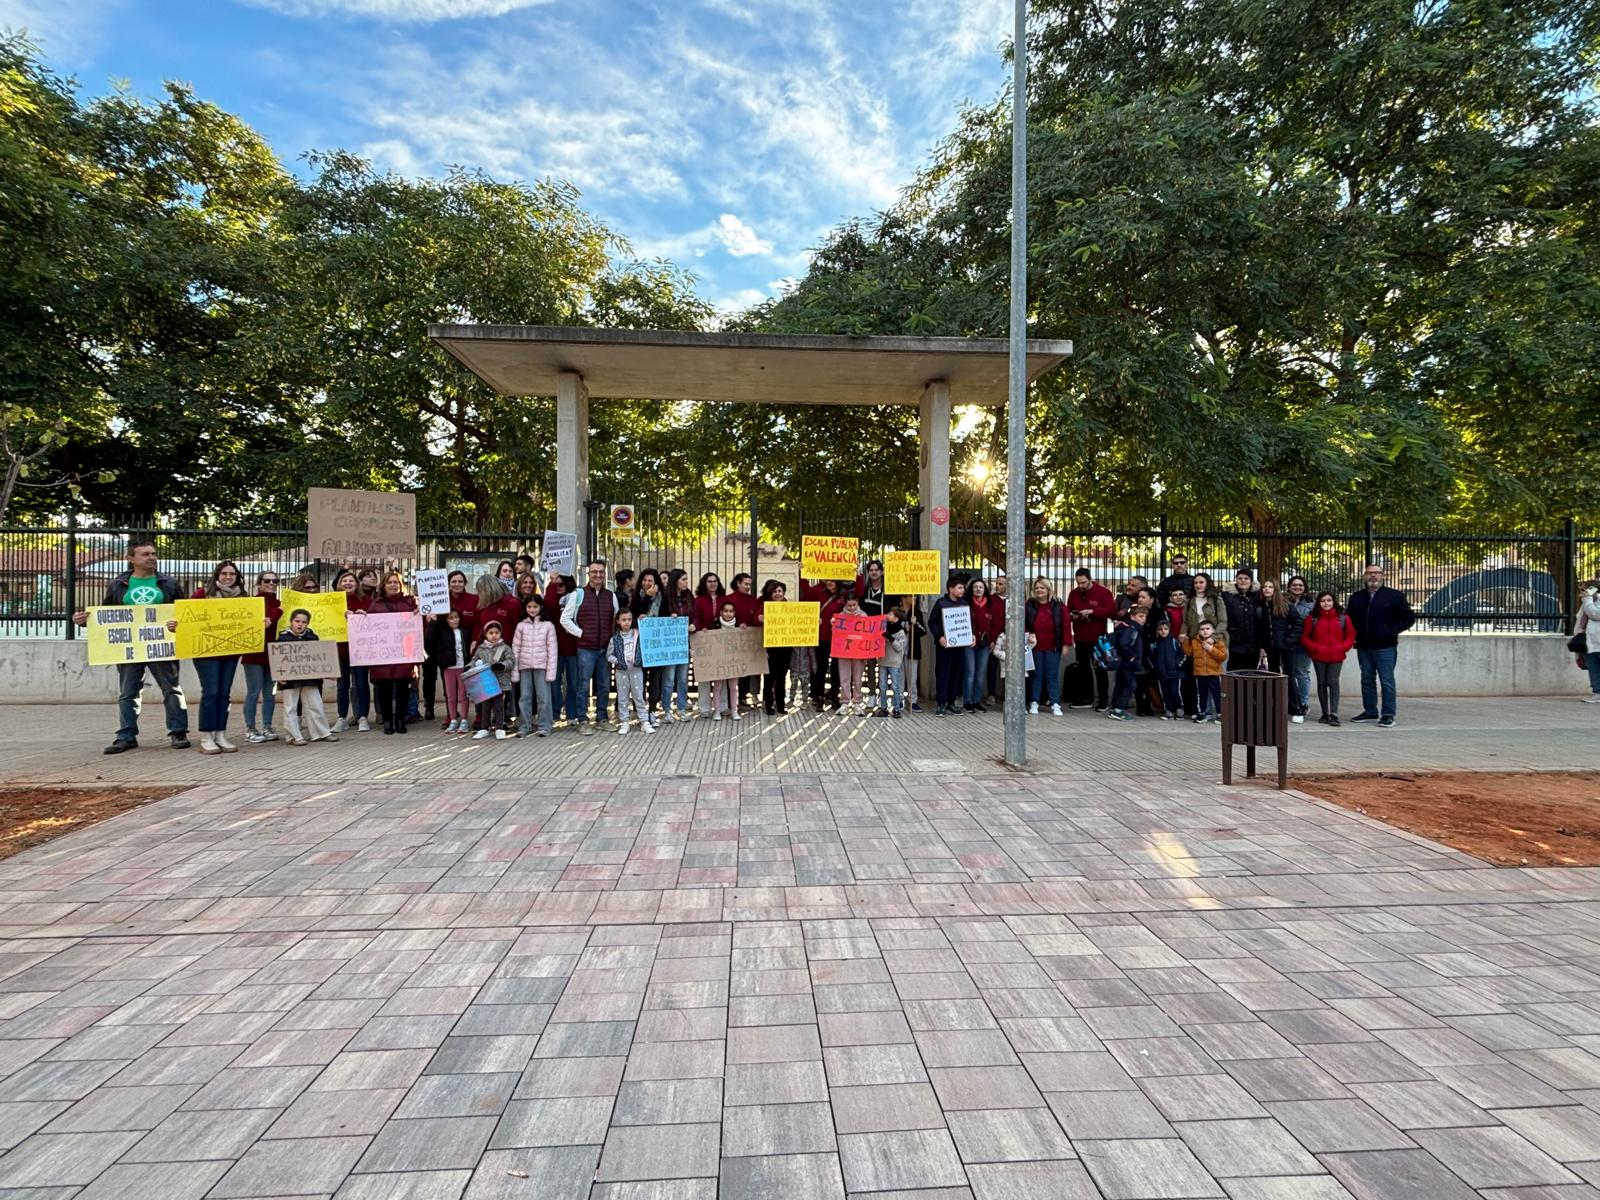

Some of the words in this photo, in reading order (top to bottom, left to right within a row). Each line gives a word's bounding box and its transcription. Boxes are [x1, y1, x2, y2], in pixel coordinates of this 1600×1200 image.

[804, 538, 828, 547] ESCOLA
[545, 550, 572, 559] QUALITAT
[806, 567, 822, 575] ARA
[97, 608, 134, 625] QUEREMOS
[145, 608, 156, 623] UNA
[108, 627, 132, 644] ESCUELA
[139, 625, 165, 641] PÚBLICA
[126, 646, 134, 660] DE
[146, 642, 176, 659] CALIDA
[271, 643, 309, 656] MENYS
[281, 653, 327, 664] ALUMNAT
